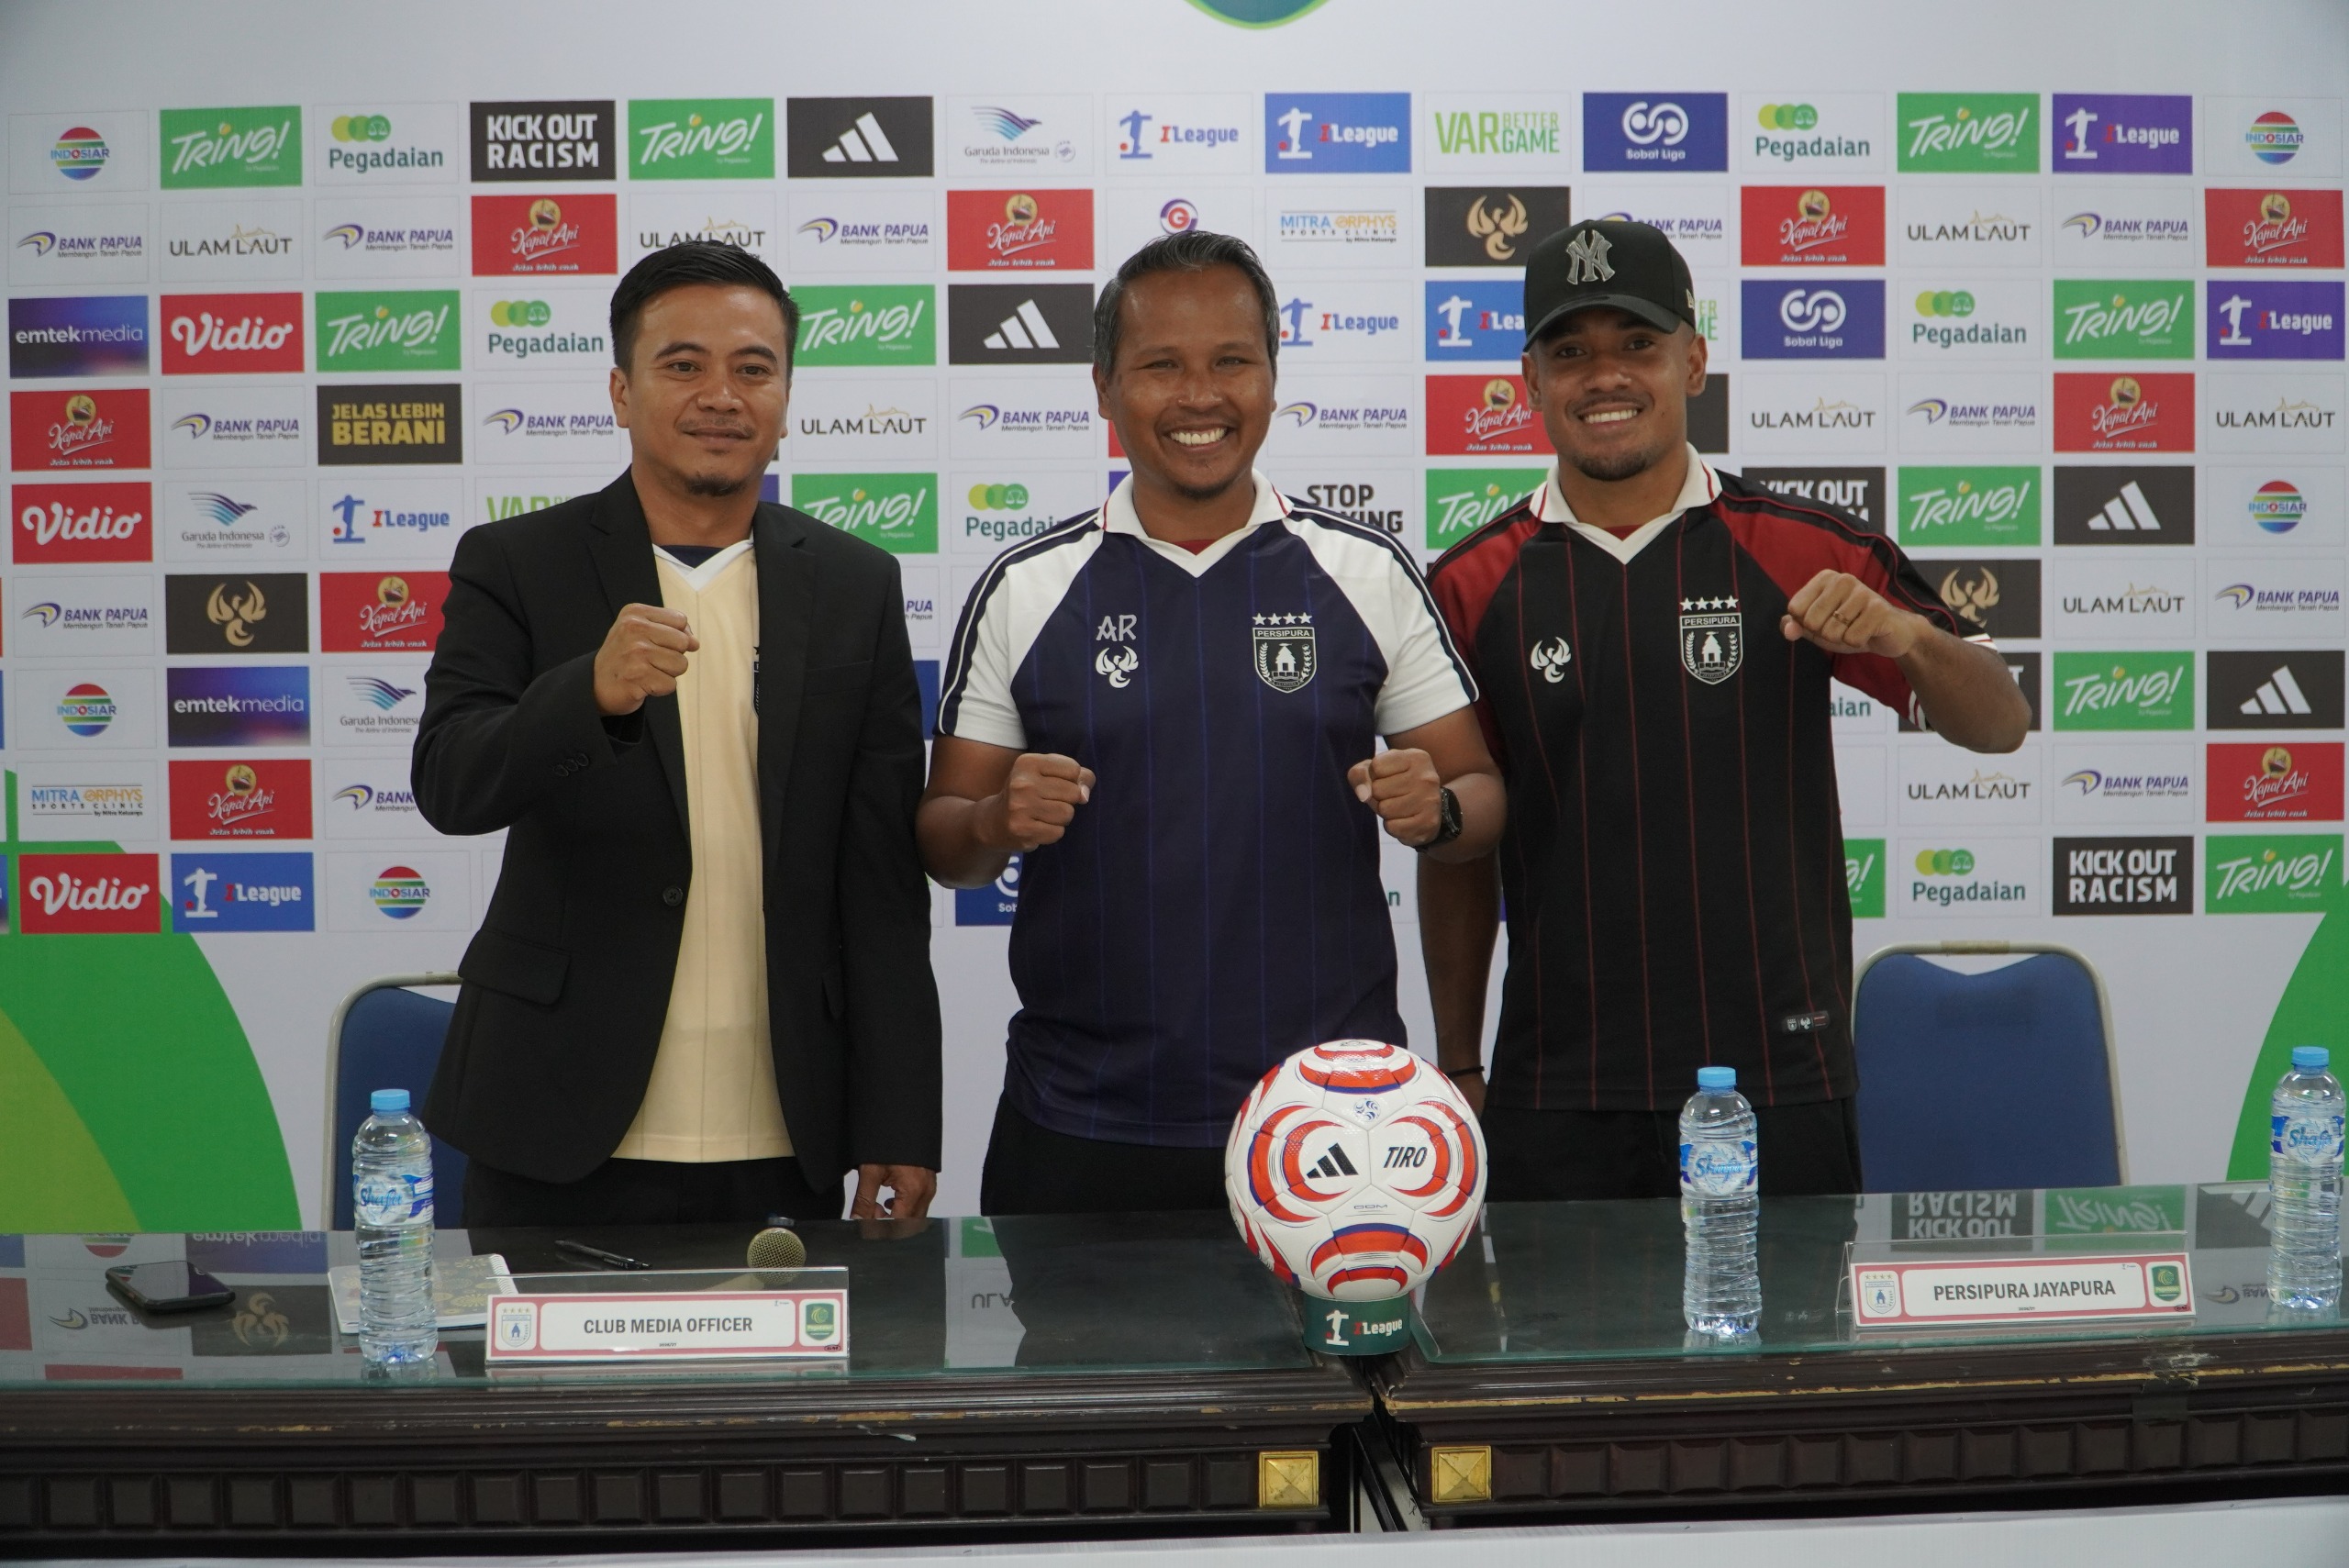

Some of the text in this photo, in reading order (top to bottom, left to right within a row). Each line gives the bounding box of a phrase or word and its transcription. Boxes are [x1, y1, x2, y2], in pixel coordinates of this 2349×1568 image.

[486, 113, 598, 141] KICK OUT
[1502, 112, 1560, 130] BETTER
[1434, 111, 1501, 154] VAR
[2245, 131, 2304, 145] INDOSIAR
[1502, 129, 1561, 155] GAME
[1756, 137, 1870, 161] Pegadaian
[50, 148, 110, 160] INDOSIAR
[329, 147, 443, 173] Pegadaian
[486, 141, 599, 169] RACISM
[964, 147, 1049, 156] Garuda Indonesia
[1626, 149, 1686, 161] Sobat Liga
[841, 224, 929, 237] BANK PAPUA
[1280, 215, 1331, 228] MITRA
[1678, 217, 1723, 231] PAPUA
[2104, 220, 2188, 233] BANK PAPUA
[366, 229, 453, 243] BANK PAPUA
[511, 223, 579, 255] Kapal Api
[986, 220, 1056, 255] Kapal Api
[1280, 228, 1397, 237] SPORTS CLINIC
[1780, 215, 1848, 247] Kapal Api
[1908, 225, 2031, 241] ULAM LAUT
[2243, 219, 2308, 249] Kapal Api
[59, 236, 142, 250] BANK PAPUA
[170, 238, 293, 256] ULAM LAUT
[841, 238, 881, 246] Membangun
[907, 237, 929, 245] Papua
[16, 323, 143, 344] emtekmedia
[171, 312, 293, 356] Vidio
[1784, 336, 1843, 349] Sobat Liga
[1913, 323, 2026, 349] Pegadaian
[489, 332, 603, 359] Pegadaian
[331, 402, 445, 420] JELAS LEBIH
[1002, 410, 1090, 424] BANK PAPUA
[1319, 408, 1408, 421] BANK PAPUA
[1751, 411, 1876, 428] ULAM LAUT
[1950, 406, 2036, 418] BANK PAPUA
[2092, 402, 2158, 432] Kapal Api
[2216, 412, 2335, 428] ULAM LAUT
[214, 419, 299, 433] BANK PAPUA
[527, 415, 614, 428] BANK PAPUA
[801, 417, 927, 435] ULAM LAUT
[1465, 406, 1532, 437] Kapal Api
[48, 419, 115, 450] Kapal Api
[331, 419, 446, 446] BERANI
[2247, 502, 2307, 515] INDOSIAR
[22, 502, 142, 545] Vidio
[965, 516, 1063, 541] Pegadai
[182, 531, 264, 541] Garuda Indonesia
[2063, 596, 2185, 614] ULAM LAUT
[2256, 591, 2340, 604] BANK PAPUA
[64, 608, 148, 622] BANK PAPUA
[359, 602, 428, 631] Kapal Api
[1684, 617, 1737, 626] PERSIPURA
[1096, 613, 1138, 644] AR
[1257, 629, 1310, 638] PERSIPURA
[56, 705, 117, 716] INDOSIAR
[173, 693, 304, 716] emtekmedia
[340, 716, 419, 727] Garuda Indonesi
[1908, 783, 2031, 800] ULAM LAUT
[2104, 776, 2188, 789] BANK PAPUA
[2243, 771, 2308, 803] Kapal Api
[31, 789, 81, 803] MITRA
[206, 789, 275, 819] Kapal Api
[2069, 849, 2177, 876] KICK OUT
[29, 873, 150, 915] Vidio
[369, 887, 431, 899] INDOSIAR
[1913, 881, 2025, 906] Pegadaian
[2068, 876, 2177, 903] RACISM
[1384, 1147, 1427, 1168] TIRO
[1933, 1279, 2117, 1302] PERSIPURA JAYAPURA
[584, 1318, 752, 1334] CLUB MEDIA OFFICER
